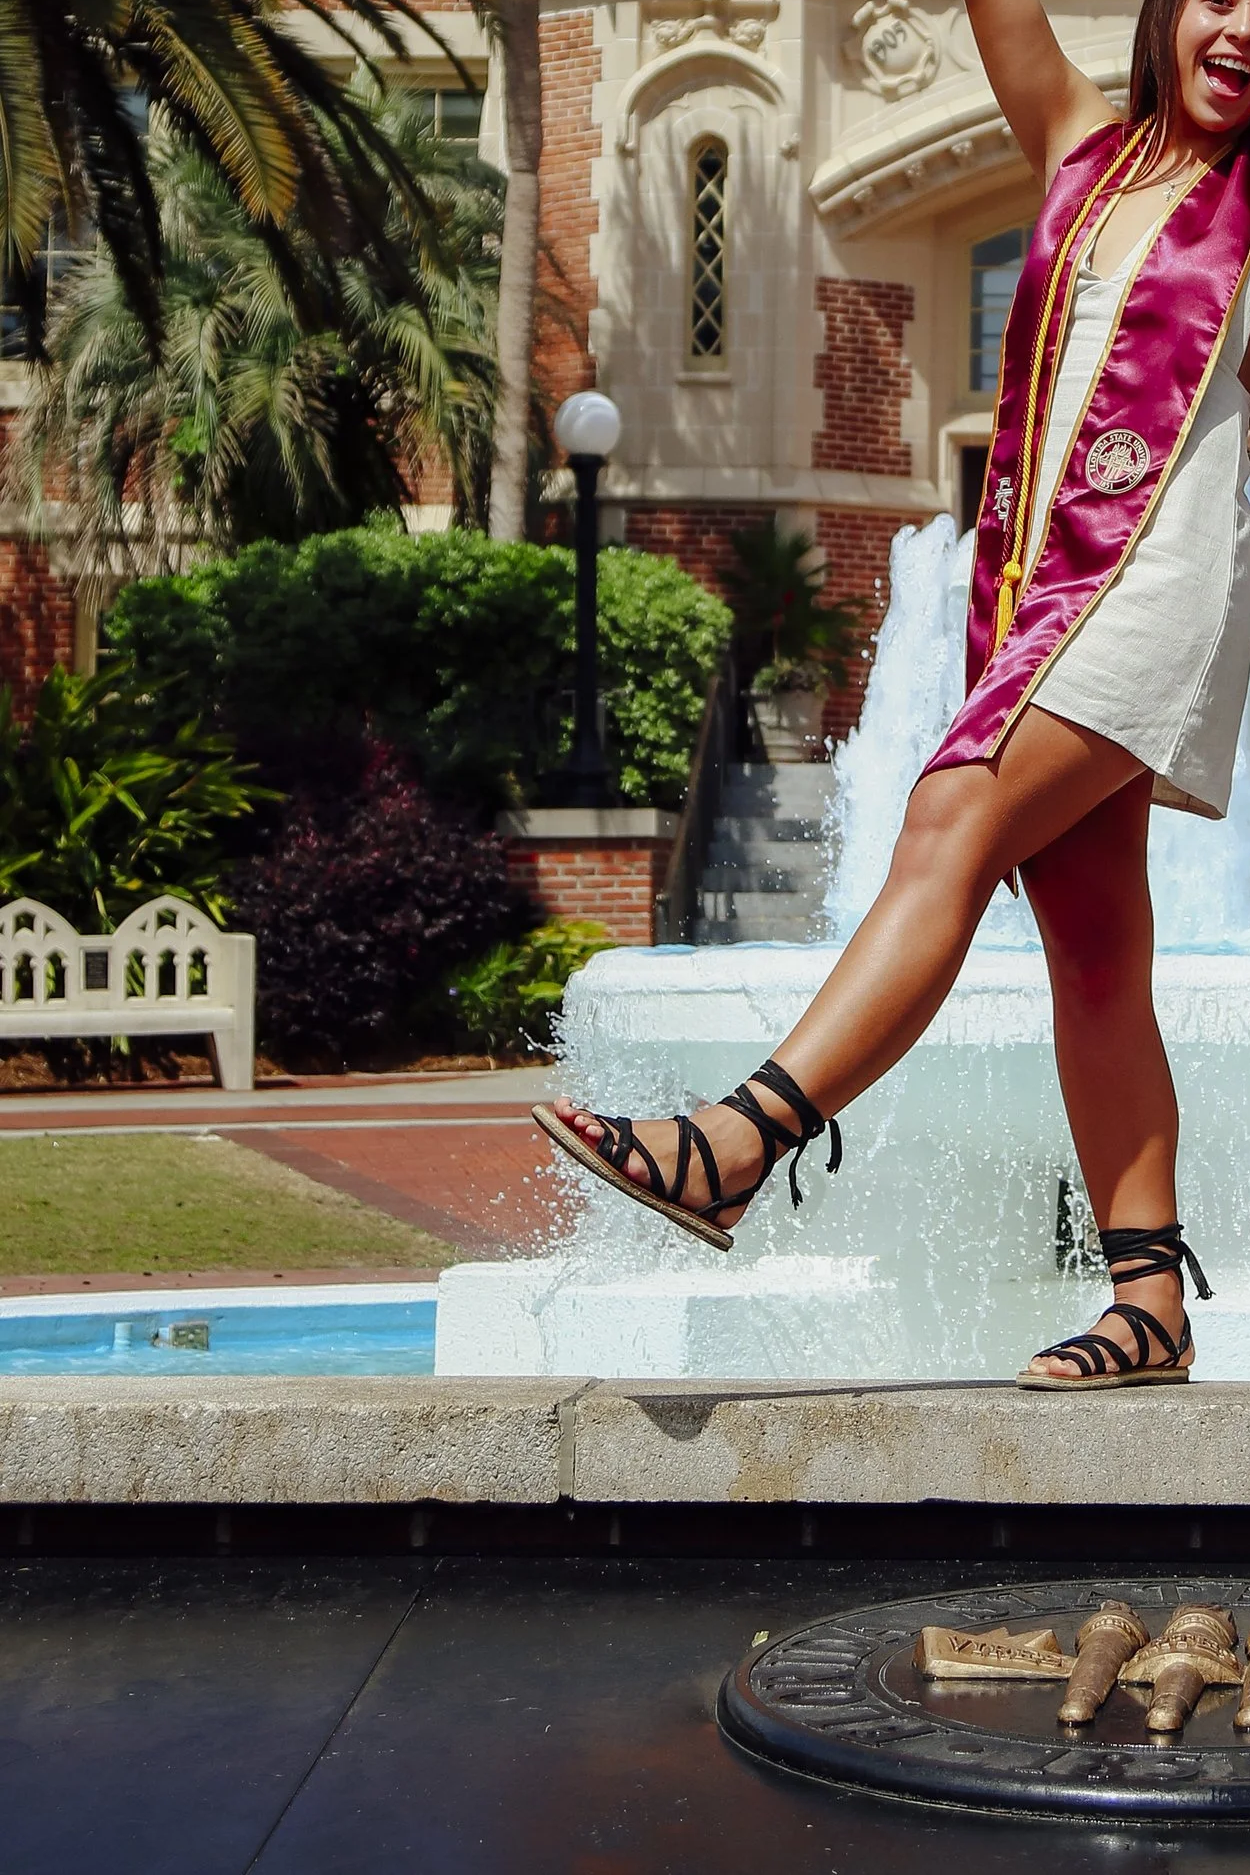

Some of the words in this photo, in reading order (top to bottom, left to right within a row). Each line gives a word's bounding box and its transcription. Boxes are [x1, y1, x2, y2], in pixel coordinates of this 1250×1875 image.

[1089, 439, 1109, 473] FLORIDA
[1109, 433, 1133, 442] STATE
[1128, 439, 1146, 485] UNIVERSITY
[1099, 480, 1114, 490] 1851
[947, 1635, 1063, 1668] VIRES
